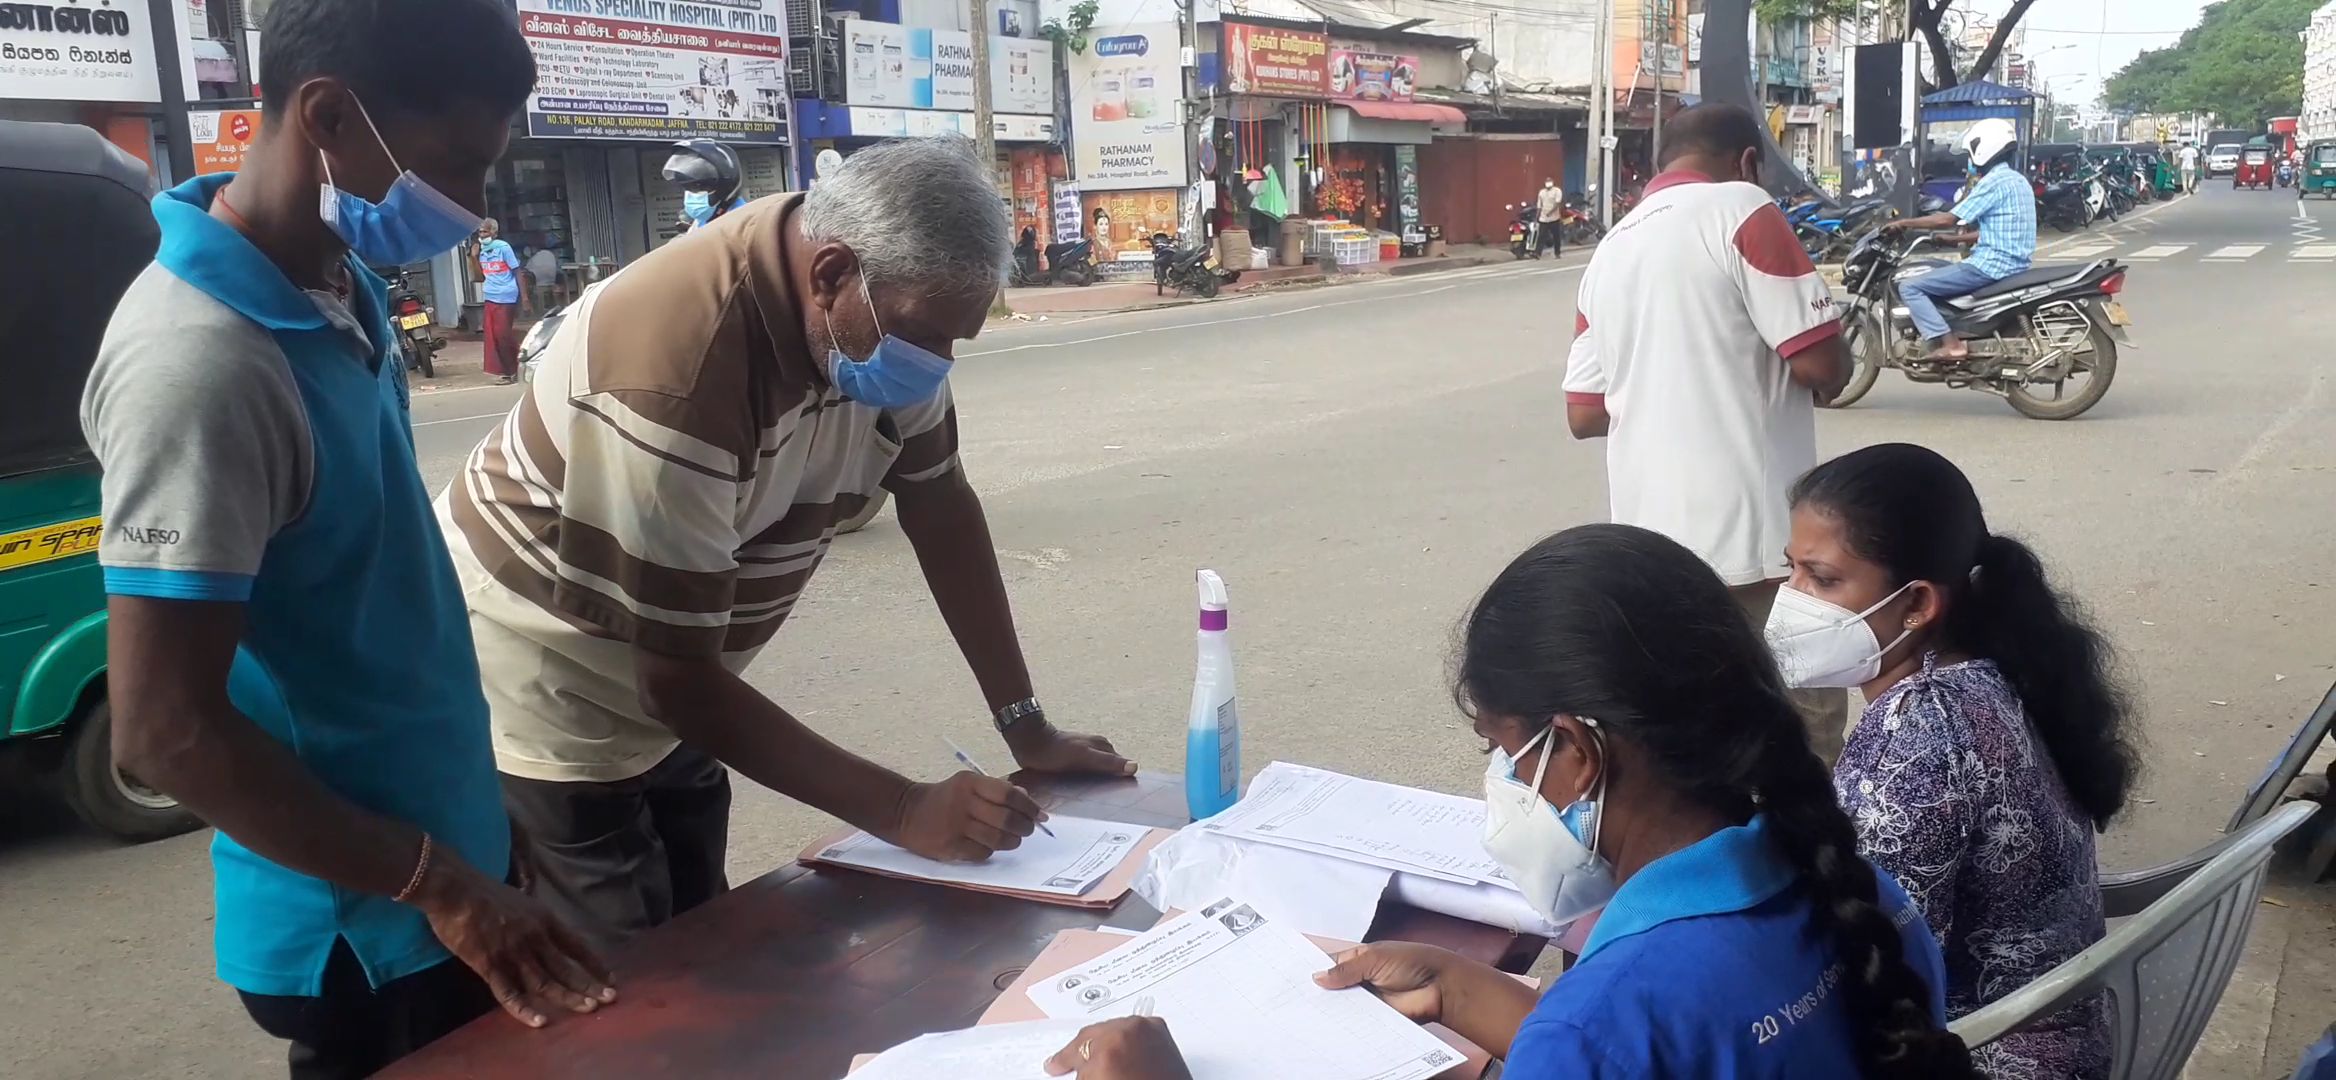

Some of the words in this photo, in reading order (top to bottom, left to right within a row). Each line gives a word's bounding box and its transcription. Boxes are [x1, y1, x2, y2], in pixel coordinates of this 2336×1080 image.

[596, 0, 666, 21] SPECIALITY
[670, 3, 725, 28] HOSPITAL
[728, 9, 756, 33] (PVT)
[759, 13, 777, 33] LTD
[525, 15, 570, 35] வீனஸ்
[573, 20, 615, 39] விசேட
[617, 25, 709, 47] வைத்தியசாலை
[2, 43, 60, 61] සියපත
[537, 41, 546, 50] 24
[546, 42, 563, 52] Hours
[563, 43, 584, 53] Service
[591, 45, 624, 56] Consultation
[539, 53, 554, 62] Ward
[554, 54, 580, 63] Facilities
[631, 48, 656, 58] Operation
[656, 50, 675, 59] Theatre
[589, 56, 601, 66] High
[602, 57, 631, 68] Technology
[632, 60, 659, 70] Laboratory
[579, 67, 598, 78] Digital
[612, 69, 643, 79] Department
[651, 71, 674, 82] Scanning
[540, 75, 551, 84] ETT
[560, 76, 590, 88] Endoscopy
[541, 86, 550, 96] 2D
[551, 86, 567, 96] ECHO
[648, 91, 664, 100] Dental
[574, 115, 597, 127] PALALY
[597, 117, 618, 127] ROAD,
[668, 119, 689, 129] JAFFNA
[696, 120, 707, 130] TEL:
[718, 121, 728, 130] 222
[1100, 144, 1152, 156] RATHANAM
[1102, 156, 1154, 168] PHARMACY
[1811, 297, 1834, 311] NAF
[122, 526, 180, 545] NAFSO
[1752, 1015, 1779, 1044] 20
[1778, 991, 1818, 1025] Years
[1816, 974, 1828, 999] of
